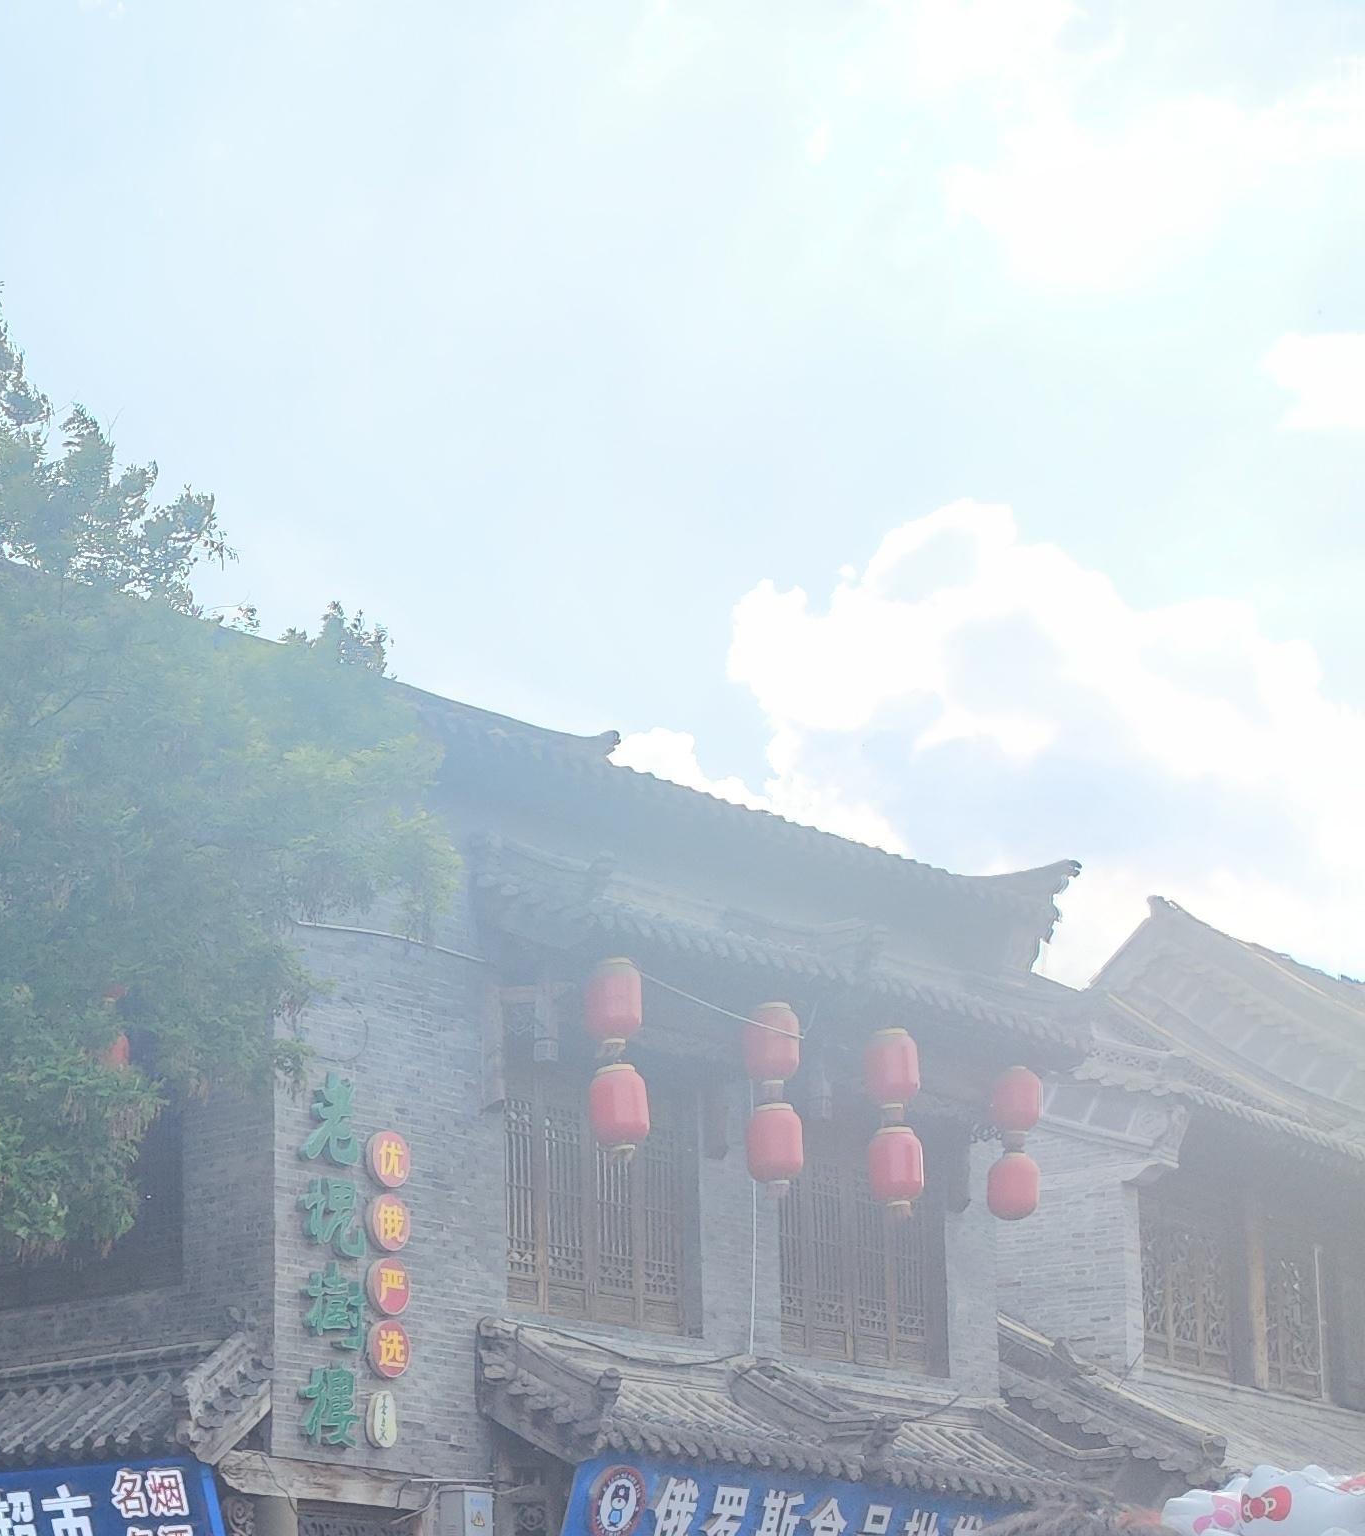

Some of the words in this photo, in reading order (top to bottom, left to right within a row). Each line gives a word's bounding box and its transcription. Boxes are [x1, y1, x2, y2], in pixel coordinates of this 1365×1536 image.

[377, 1139, 406, 1369] 优俄严选
[111, 1467, 190, 1519] 名烟
